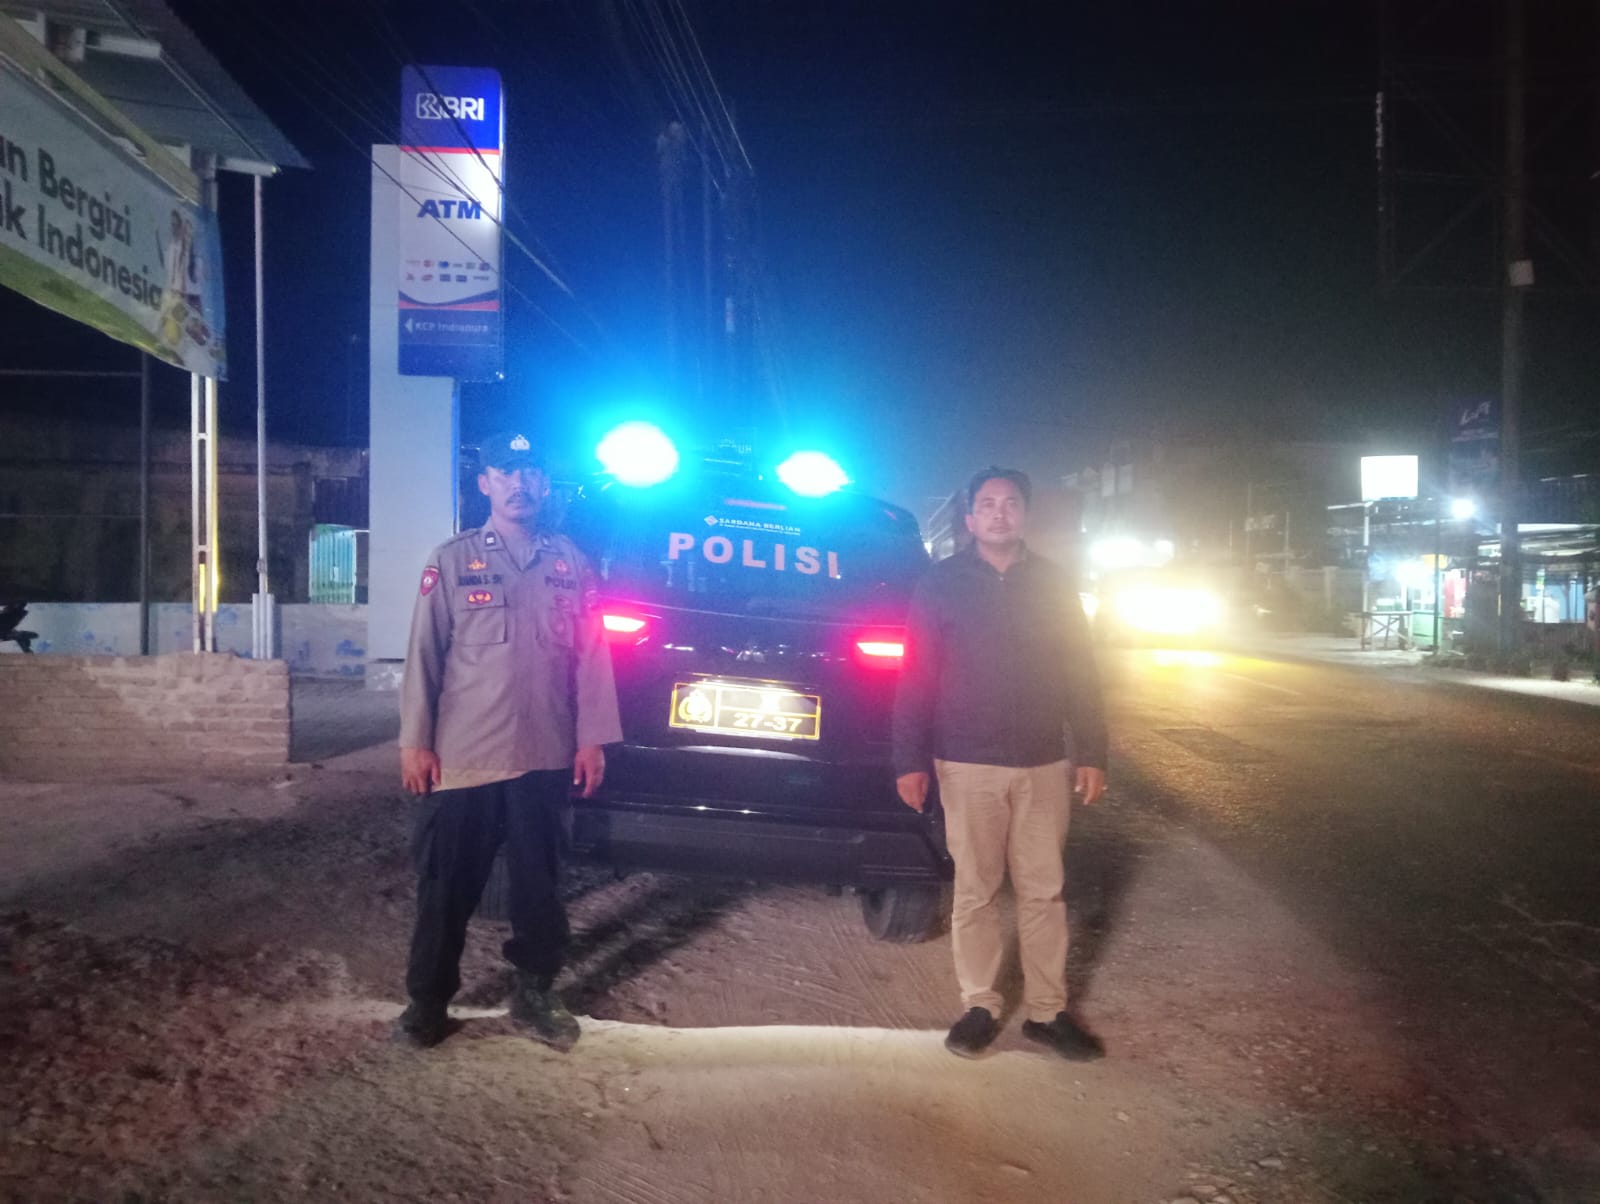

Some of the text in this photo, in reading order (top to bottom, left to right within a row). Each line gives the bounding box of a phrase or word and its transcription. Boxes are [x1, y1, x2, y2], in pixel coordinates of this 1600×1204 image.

[441, 96, 485, 121] BRI
[37, 147, 131, 247] Bergizi
[417, 199, 482, 220] ATM
[0, 178, 163, 308] k Indonesia
[668, 532, 839, 578] POLISI
[733, 712, 803, 732] 27-37
